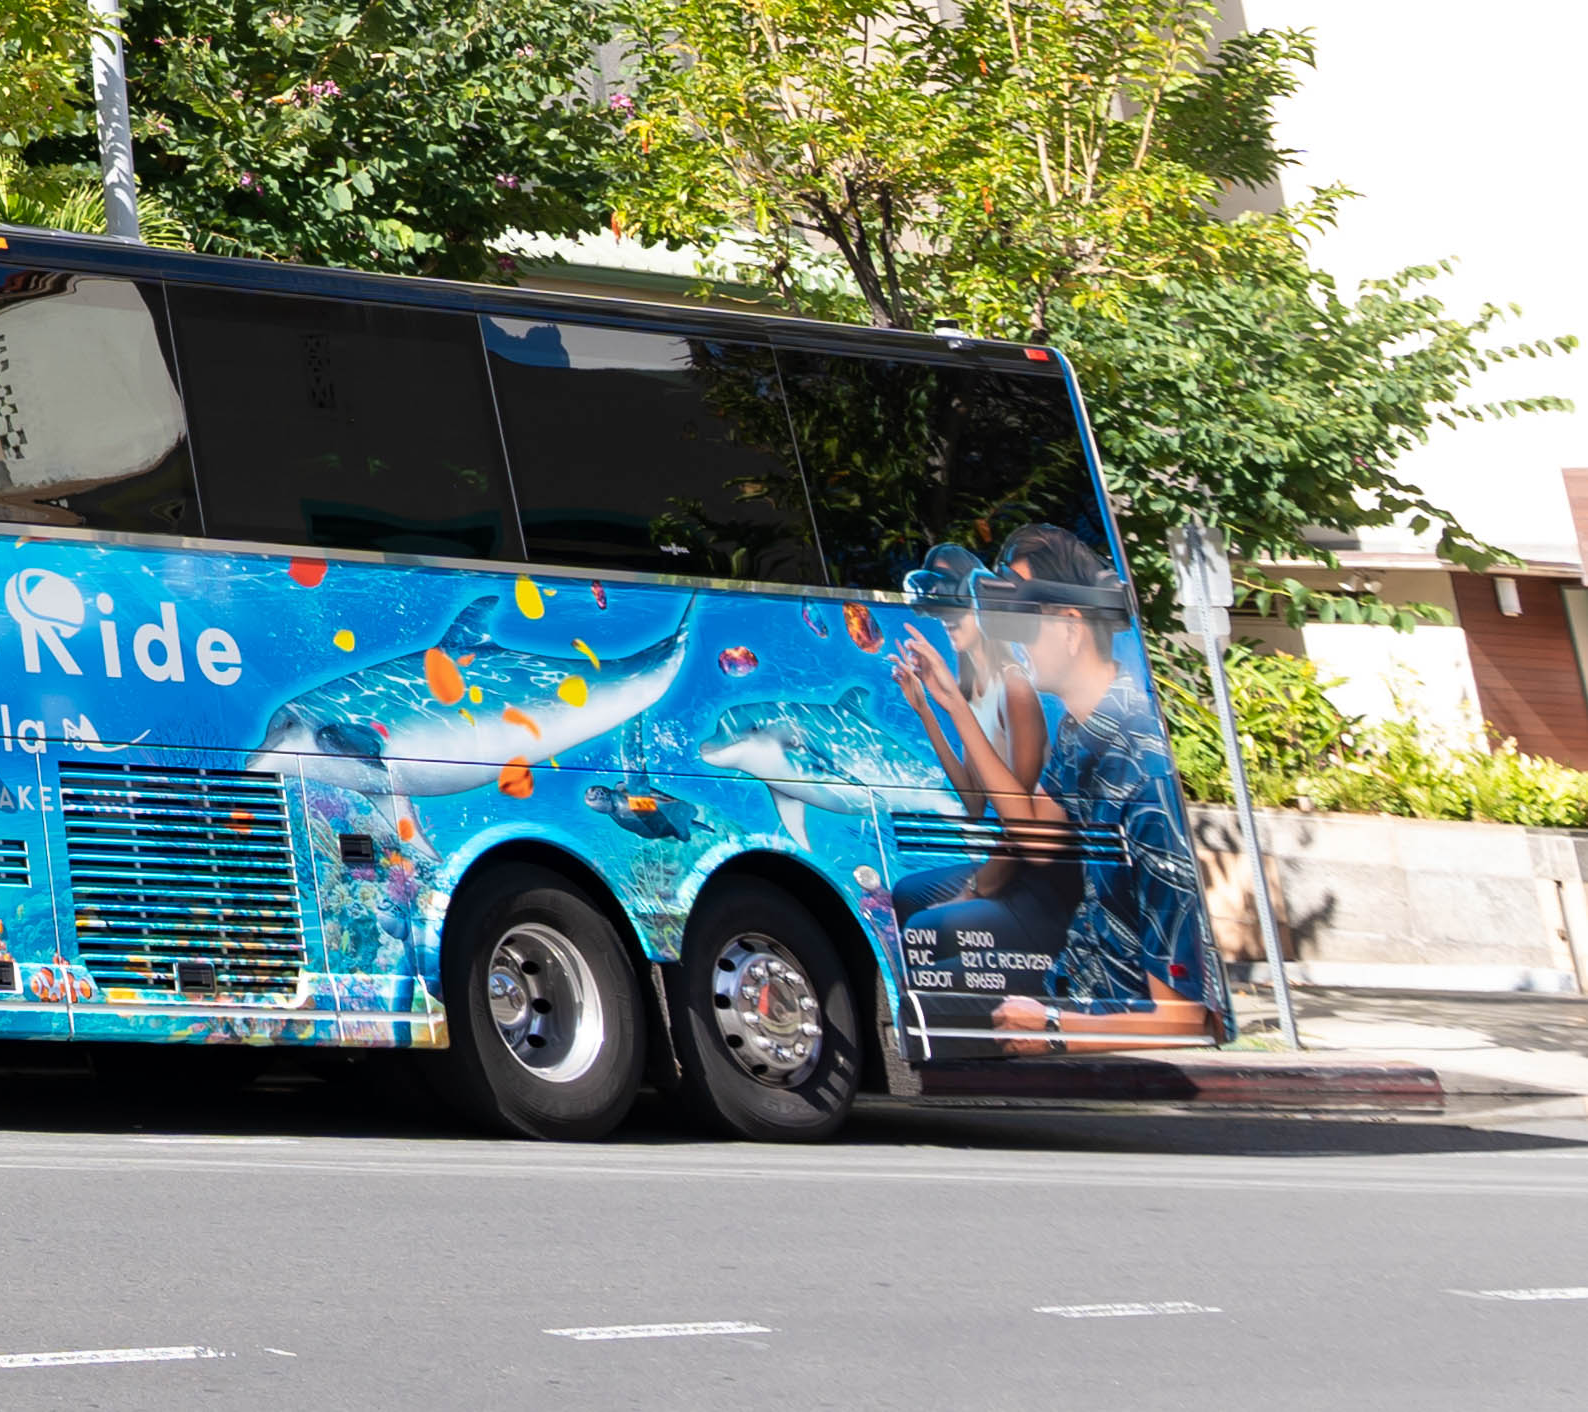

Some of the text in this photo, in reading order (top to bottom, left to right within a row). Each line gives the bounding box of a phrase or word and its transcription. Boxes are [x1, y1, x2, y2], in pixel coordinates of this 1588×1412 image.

[904, 928, 995, 948] GVW 54000
[907, 949, 936, 966] PUC
[960, 951, 984, 968] 821
[985, 952, 997, 969] C
[911, 970, 1007, 990] USDOT 896559
